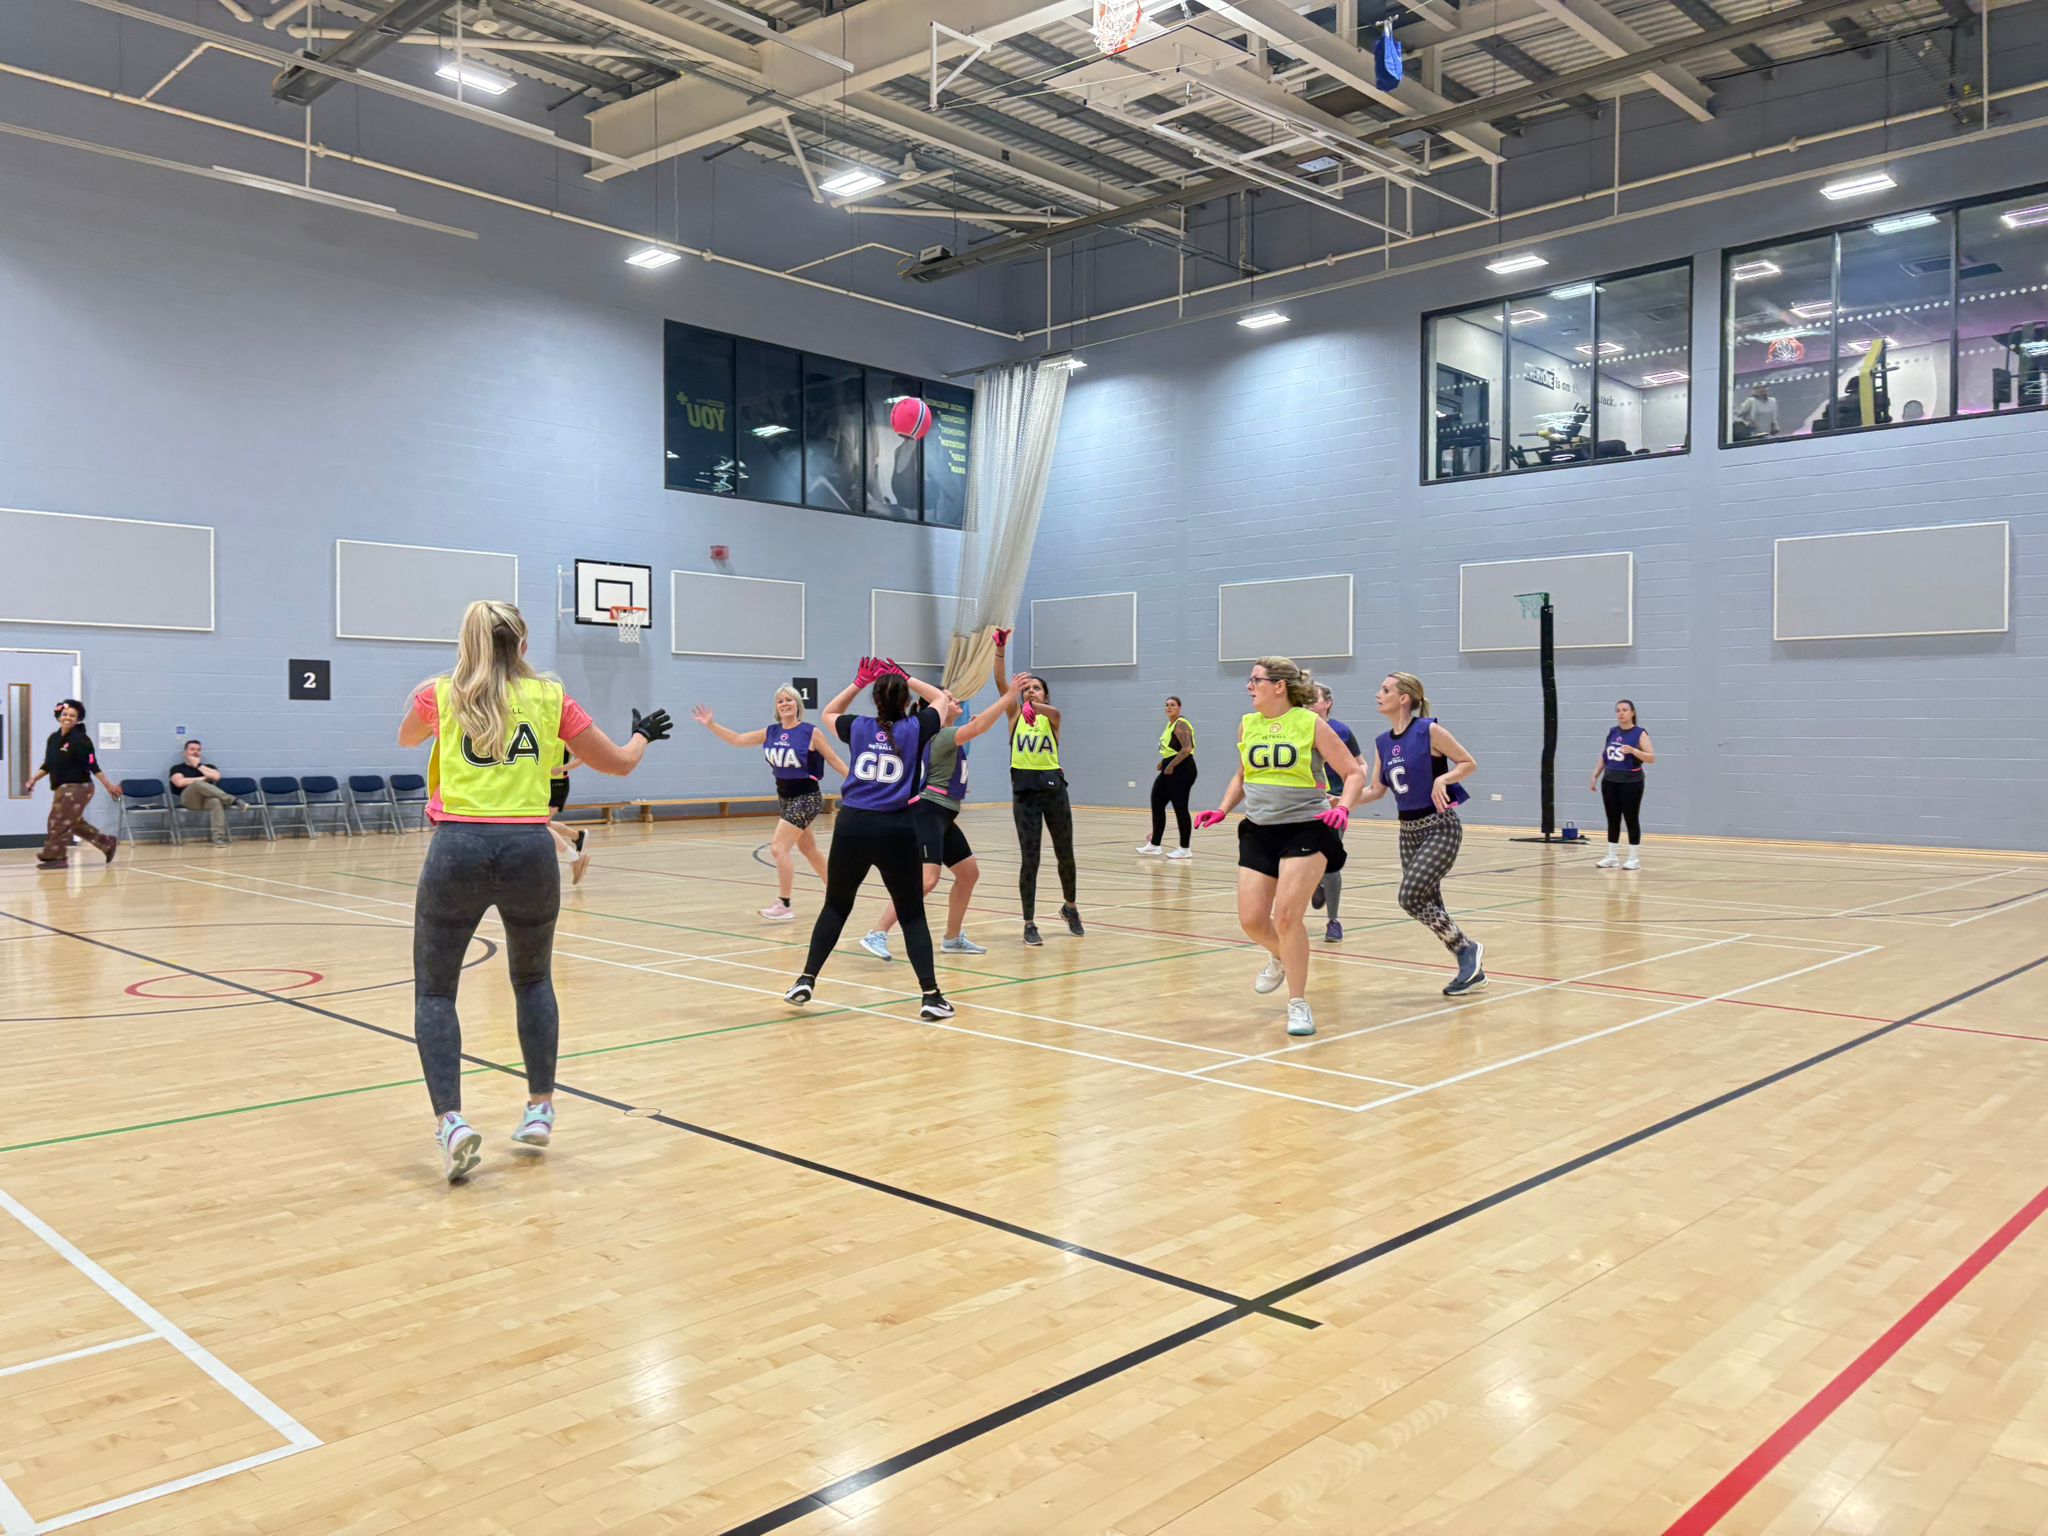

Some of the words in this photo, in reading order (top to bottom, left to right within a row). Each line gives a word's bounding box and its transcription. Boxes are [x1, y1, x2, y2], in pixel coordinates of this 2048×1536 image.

[303, 671, 317, 688] 2
[800, 687, 810, 700] 1
[1016, 734, 1054, 754] WA
[764, 747, 802, 768] WA
[1248, 743, 1299, 769] GD
[854, 751, 904, 784] GD
[1389, 765, 1409, 794] C
